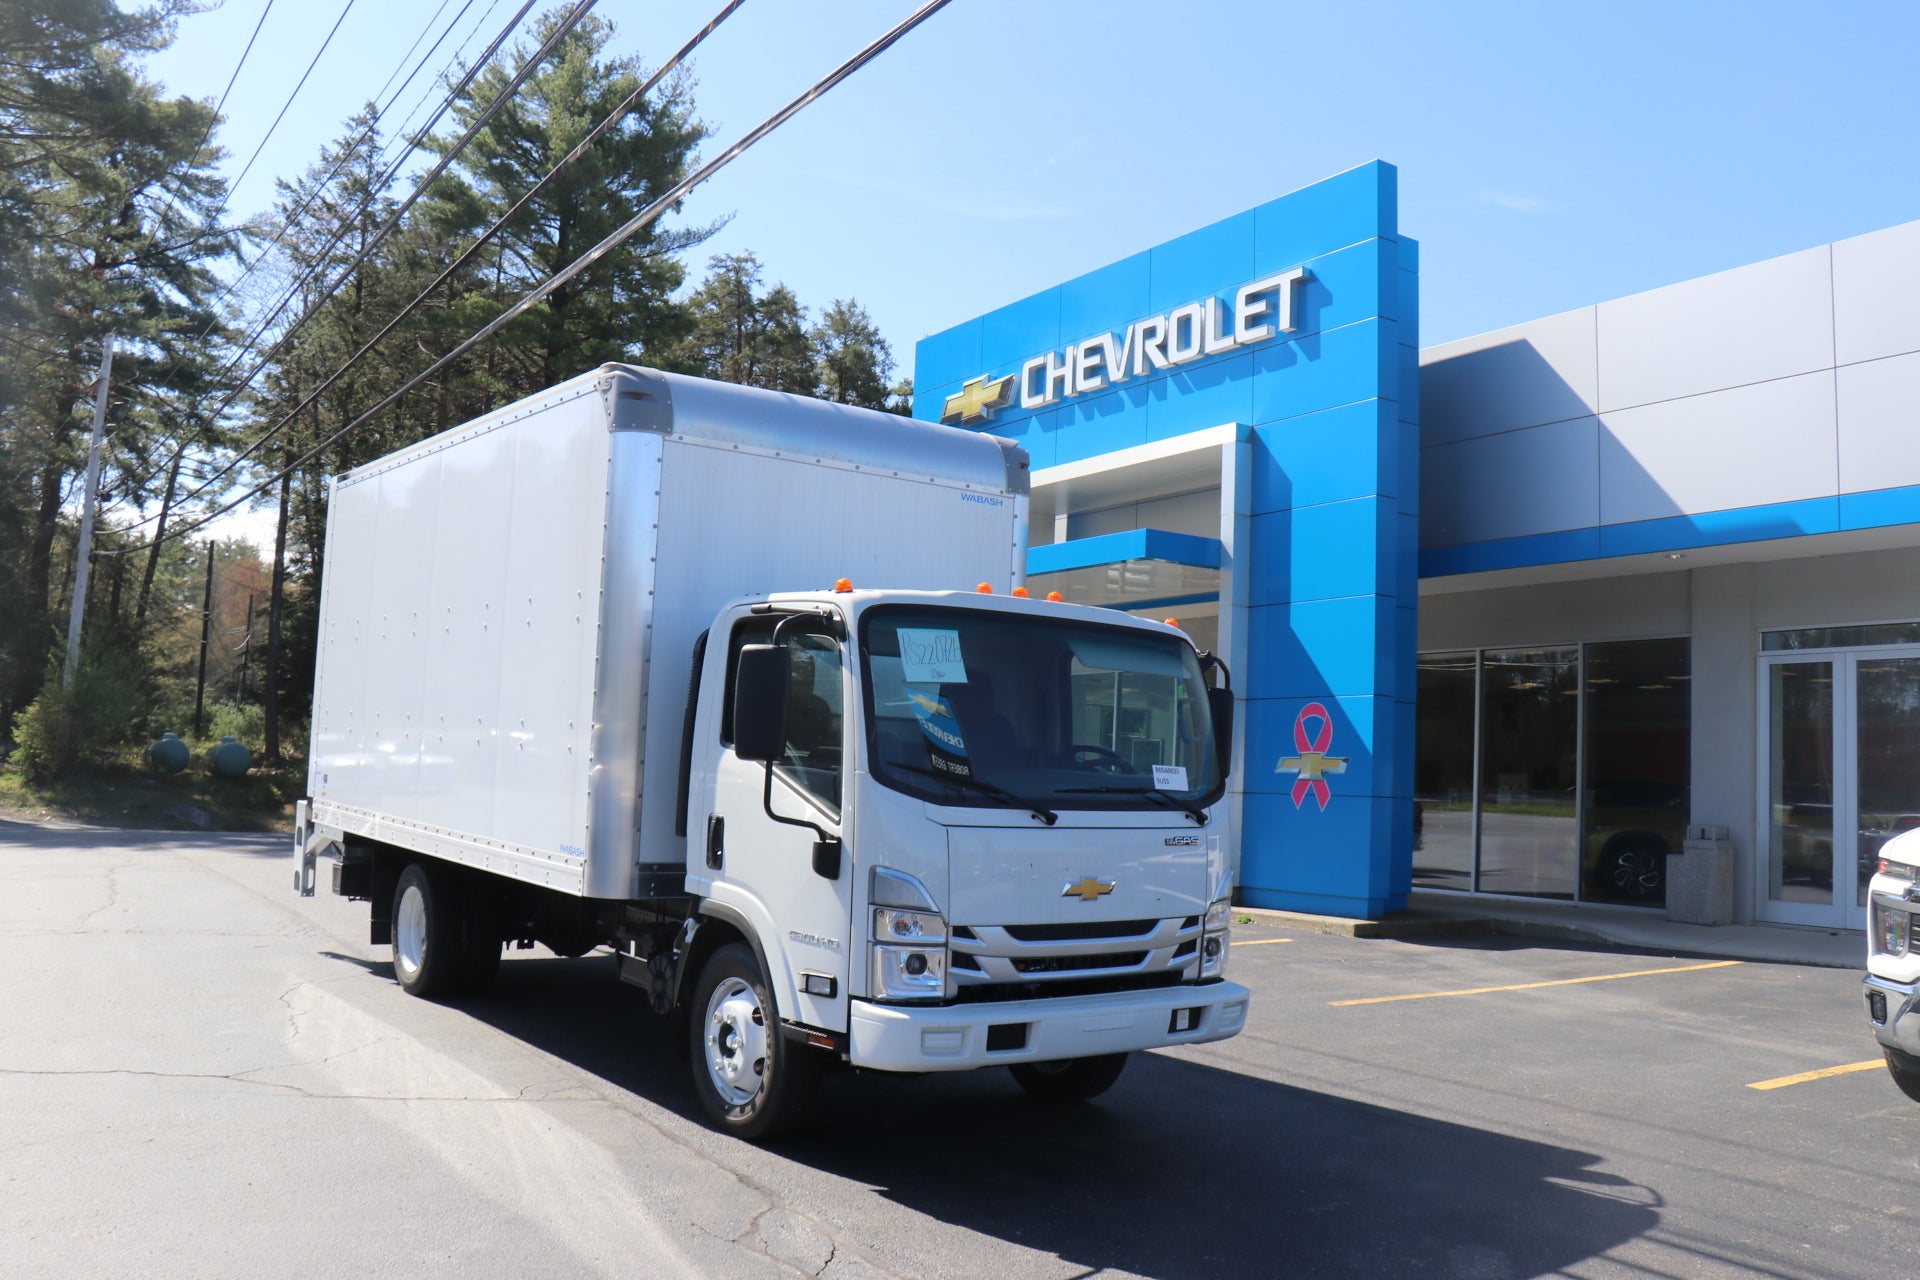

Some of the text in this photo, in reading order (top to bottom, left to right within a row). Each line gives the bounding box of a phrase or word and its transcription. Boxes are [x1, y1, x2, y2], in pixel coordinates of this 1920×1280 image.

[1021, 267, 1307, 409] CHEVROLET
[961, 493, 1003, 506] WABASH
[560, 843, 585, 857] WABASH
